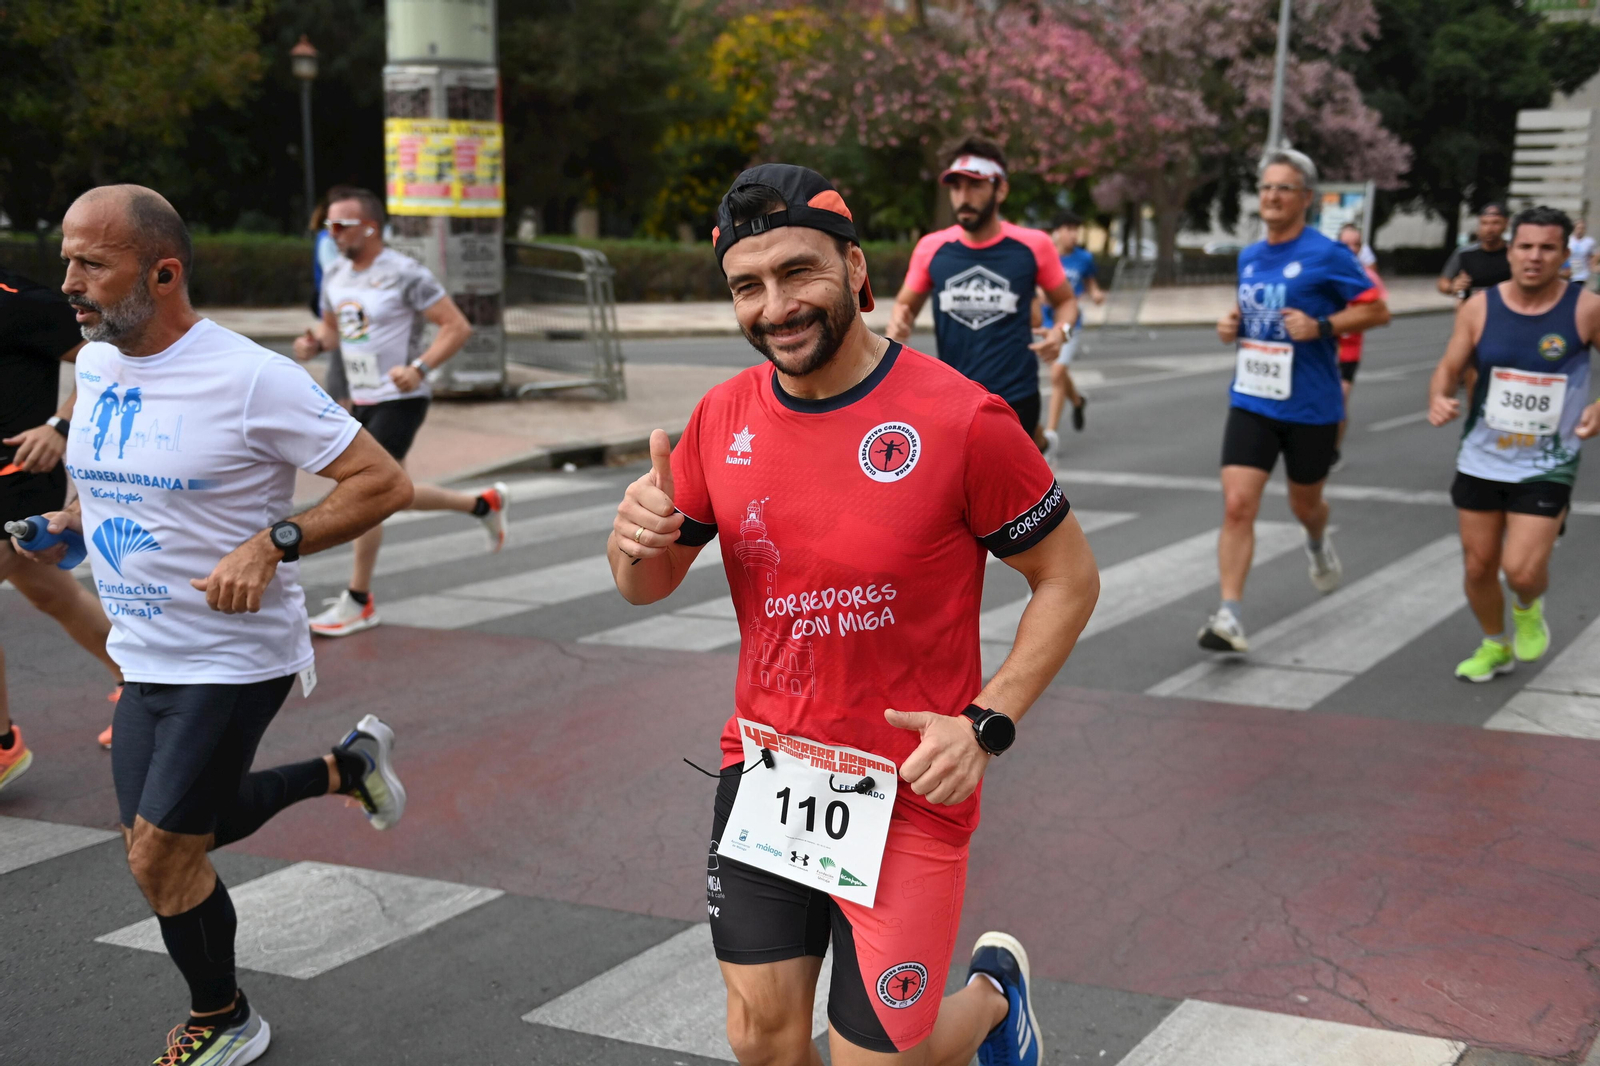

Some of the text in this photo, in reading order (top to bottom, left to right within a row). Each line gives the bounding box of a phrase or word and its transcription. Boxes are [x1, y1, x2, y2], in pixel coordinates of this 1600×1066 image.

[1239, 283, 1287, 310] RCM
[1500, 390, 1551, 412] 3808
[725, 454, 752, 466] luanvi
[862, 425, 918, 477] CLUB DEPORTIVO CORREDORES CON MIGA
[76, 468, 127, 485] CARRERA
[126, 473, 184, 490] URBANA
[98, 580, 169, 596] Fundación
[108, 602, 163, 621] Unicaja
[764, 583, 897, 618] CORREDORES
[791, 606, 895, 640] CON MIGA
[743, 725, 895, 774] 42 CARRERA URBANA
[779, 744, 804, 760] CIUDAD
[839, 783, 886, 800] FEDADO
[776, 786, 850, 840] 110
[755, 842, 783, 857] málaga
